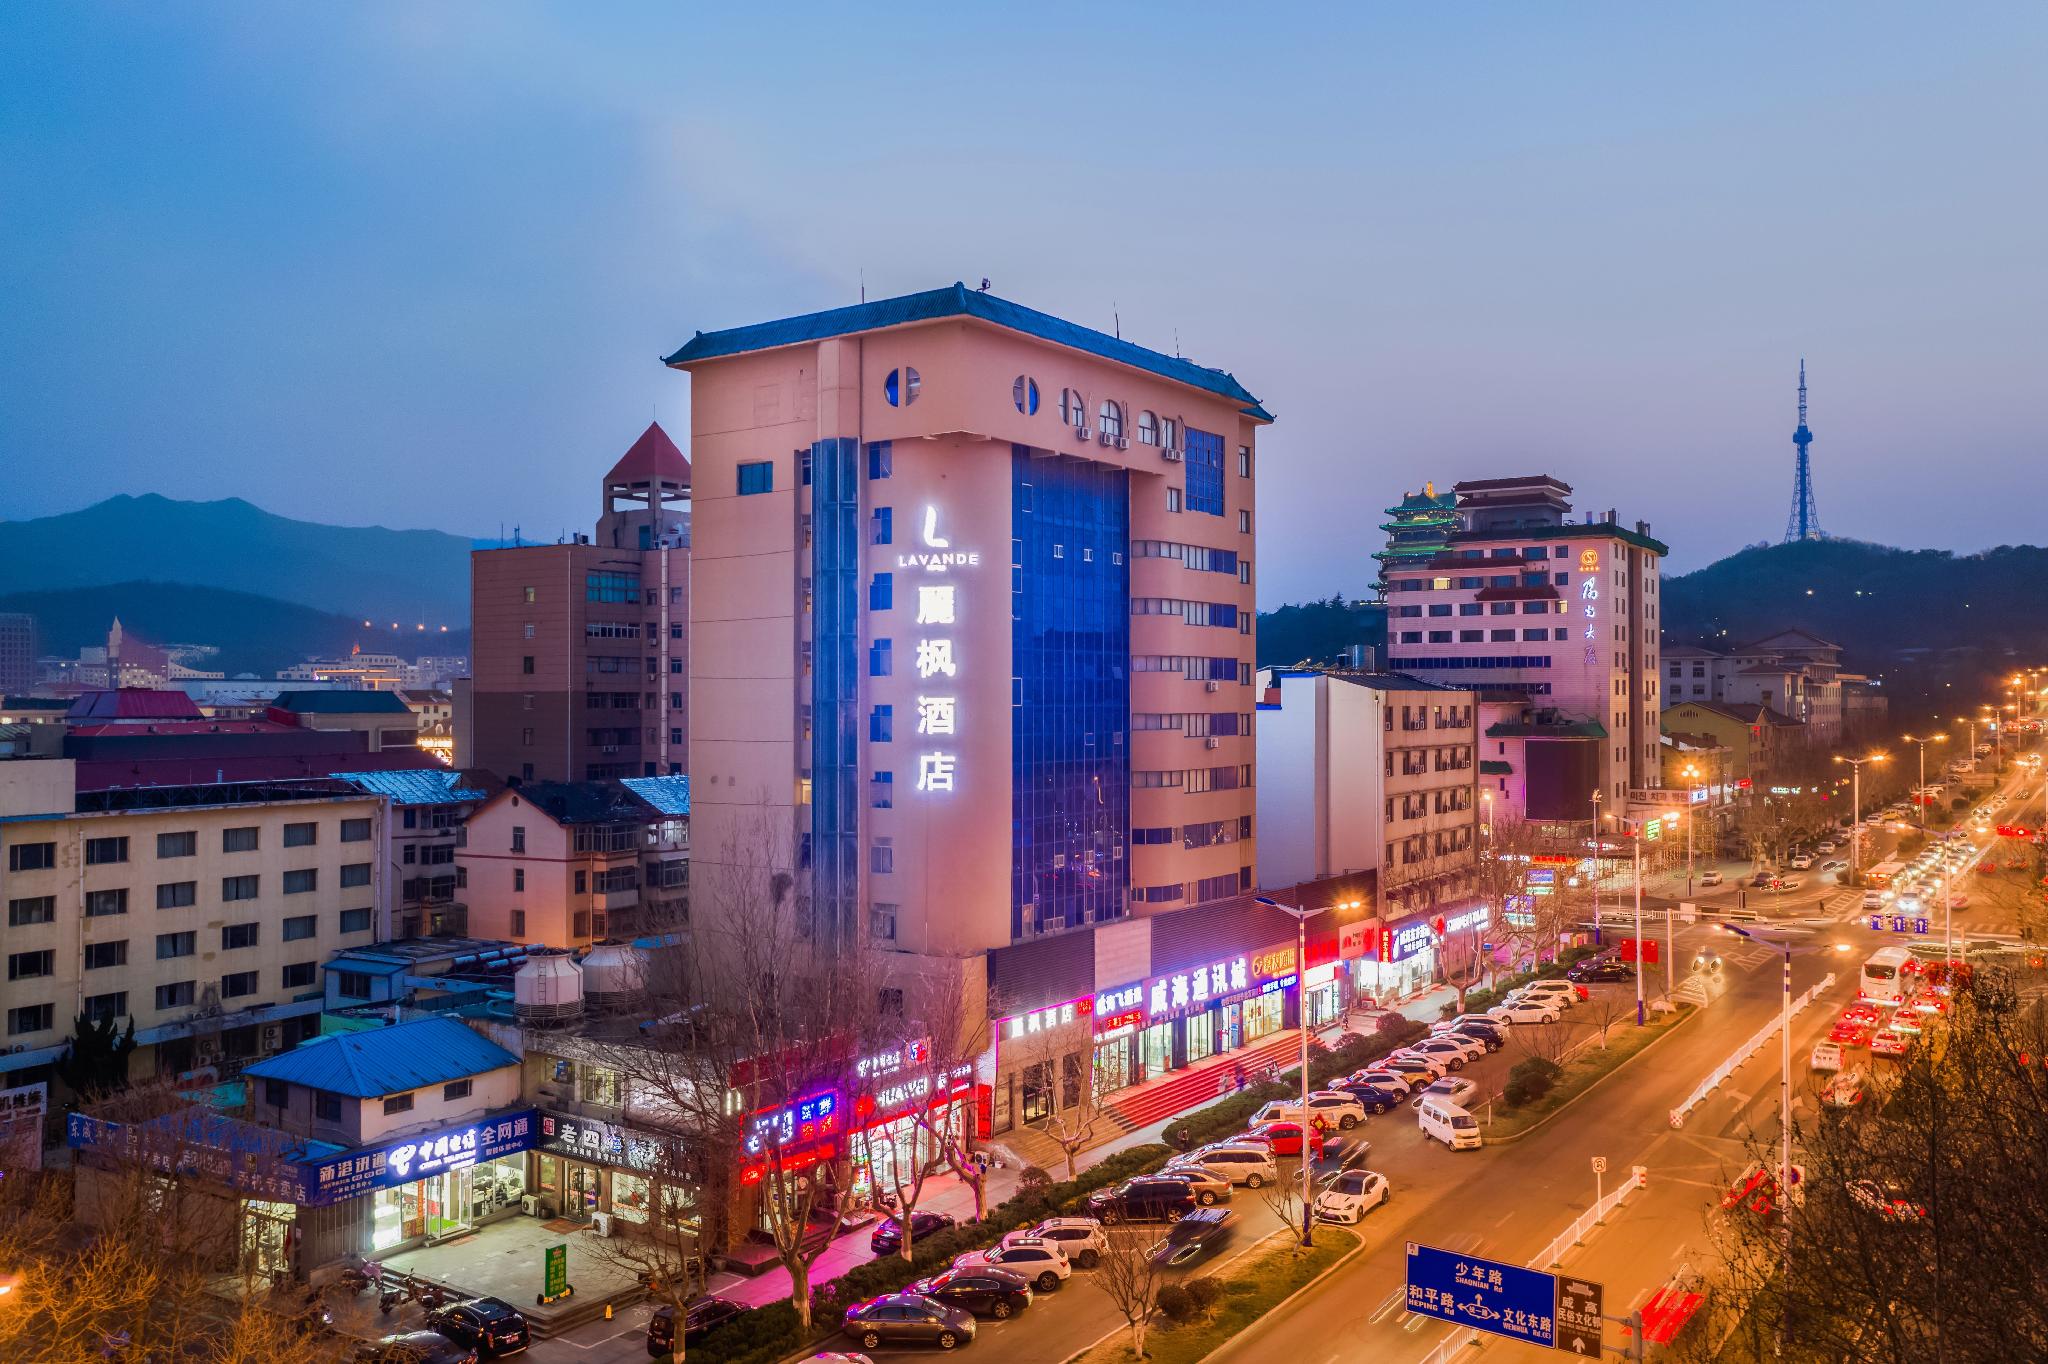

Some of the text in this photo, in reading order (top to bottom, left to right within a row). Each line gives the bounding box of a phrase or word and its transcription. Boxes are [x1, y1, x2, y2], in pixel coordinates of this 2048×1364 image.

[898, 553, 980, 568] LAVANDE
[480, 1117, 529, 1147] 全网通
[419, 1128, 476, 1161] 中国电信
[319, 1151, 387, 1183] 新港讯通
[1455, 1261, 1503, 1286] 少年路
[1455, 1276, 1503, 1294] SHAONIAN Rd
[1408, 1284, 1455, 1308] 和平路
[1408, 1298, 1455, 1316] HEPING Rd
[1502, 1321, 1529, 1335] WENHUA
[1503, 1307, 1552, 1333] 文化东路
